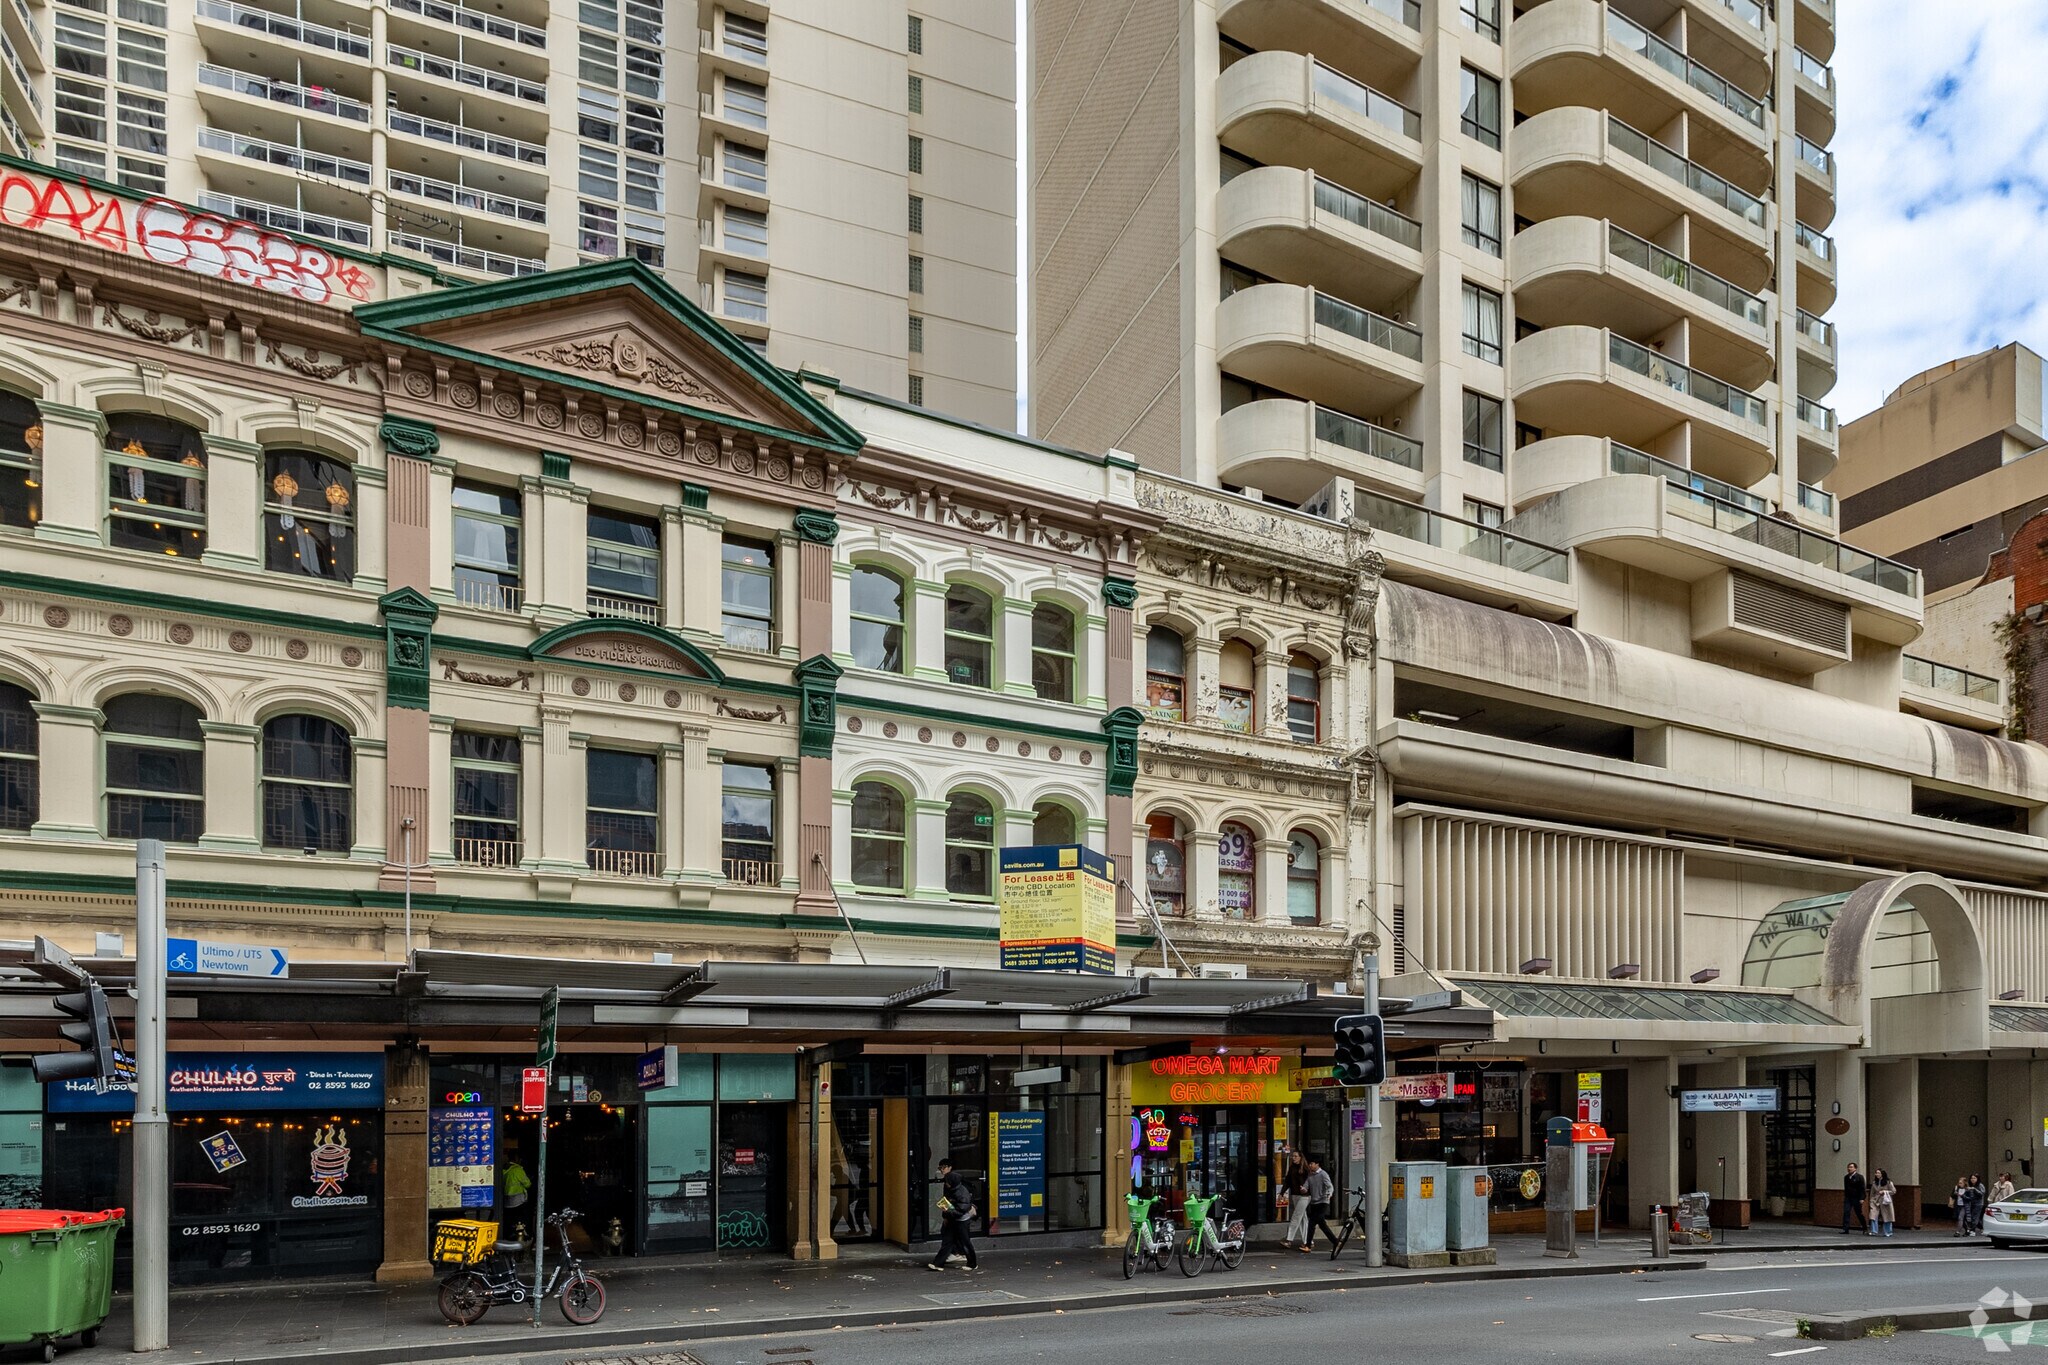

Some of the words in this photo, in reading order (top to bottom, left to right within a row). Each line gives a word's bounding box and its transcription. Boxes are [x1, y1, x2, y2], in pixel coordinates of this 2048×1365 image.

[612, 641, 643, 654] 1896
[1218, 833, 1245, 857] 69
[1218, 857, 1252, 869] assage
[1004, 875, 1021, 883] For
[1024, 874, 1054, 883] Lease
[1758, 921, 1779, 949] THE
[202, 946, 234, 957] Ultimo
[236, 949, 241, 958] /
[243, 950, 262, 959] UTS
[201, 959, 249, 971] Newtown
[1151, 1055, 1225, 1076] OMEGA
[1229, 1055, 1281, 1075] MART
[169, 1070, 258, 1085] CHULHO
[337, 1071, 374, 1080] Takeaway
[308, 1081, 322, 1089] 02
[325, 1081, 347, 1089] 8593
[350, 1081, 371, 1089] 1620
[1169, 1081, 1265, 1102] GROCERY
[445, 1092, 481, 1104] open
[1708, 1092, 1748, 1100] KALAPANI
[1178, 1115, 1199, 1124] OPEN
[291, 1195, 368, 1208] Chulho.com.au
[182, 1227, 200, 1236] 02
[202, 1224, 231, 1234] 8593
[233, 1222, 261, 1233] 1620
